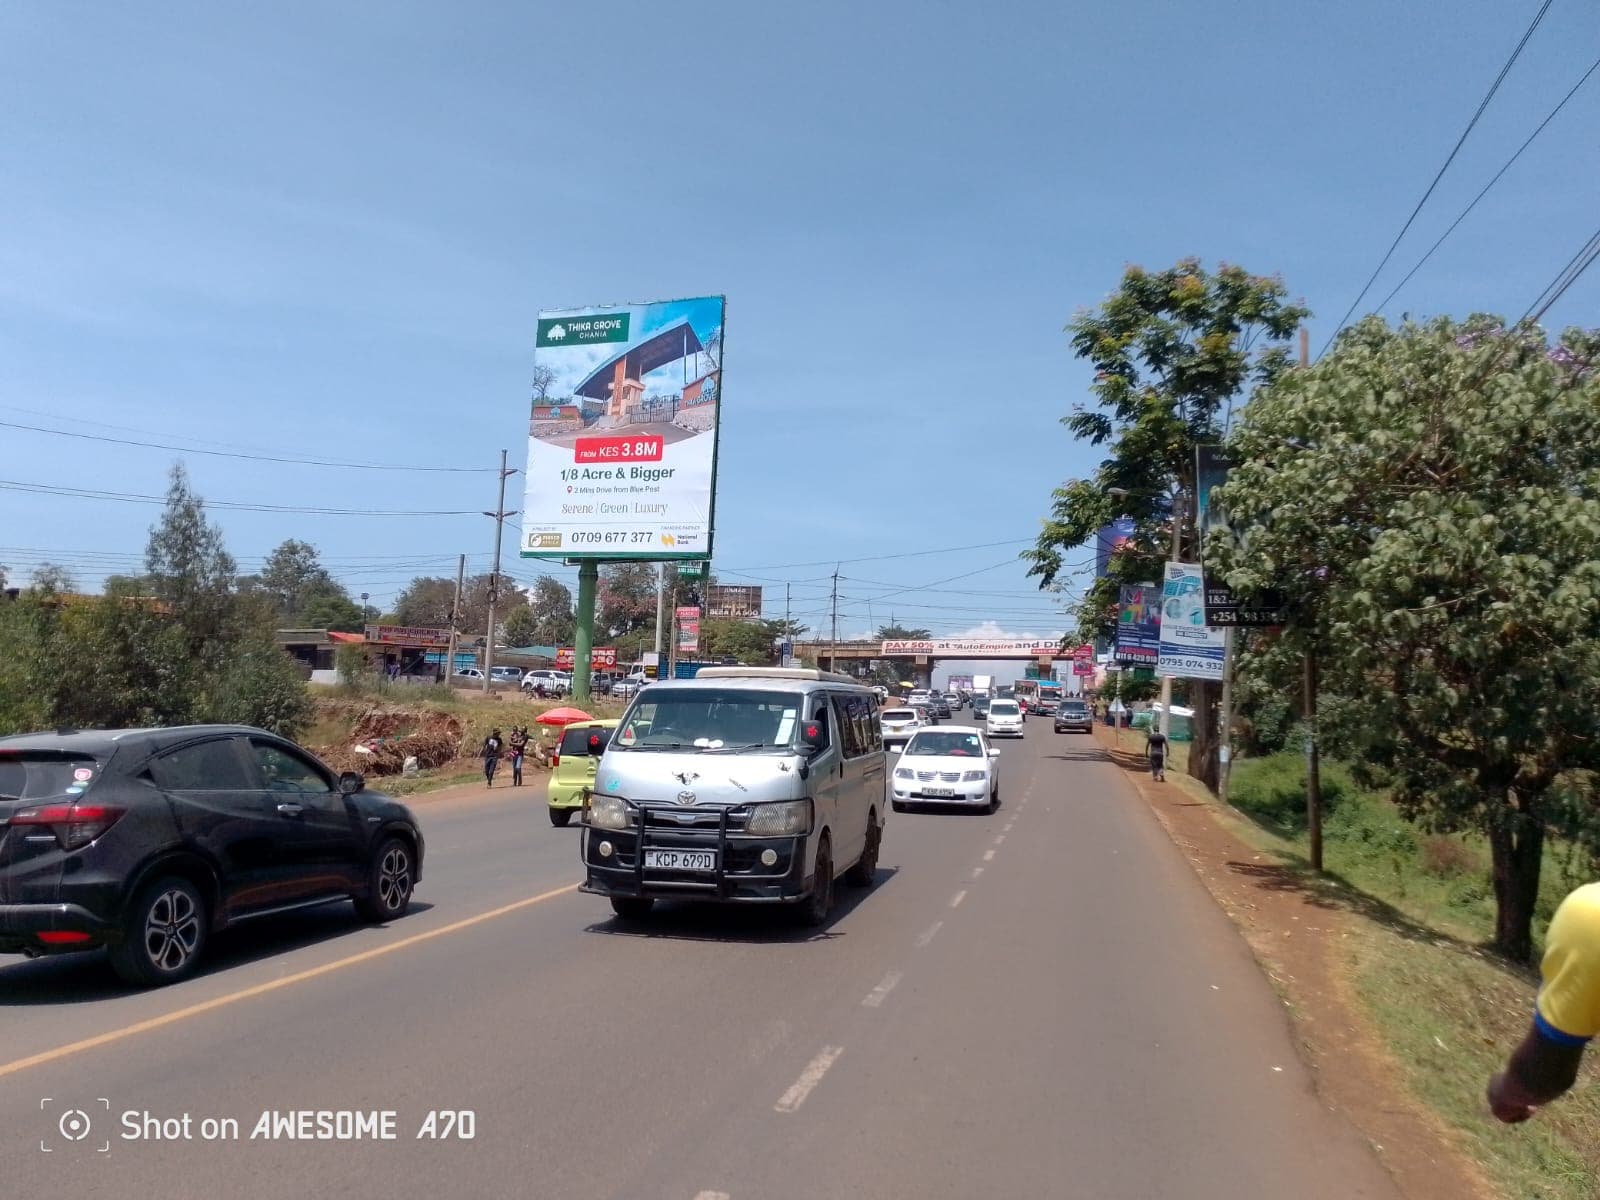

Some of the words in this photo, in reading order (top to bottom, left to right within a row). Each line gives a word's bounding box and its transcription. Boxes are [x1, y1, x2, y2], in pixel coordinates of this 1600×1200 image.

[568, 321, 591, 332] THIKA
[594, 319, 621, 330] GROVE
[579, 330, 607, 339] CHANIA
[599, 446, 619, 457] KES
[621, 441, 657, 457] 3.8M
[560, 468, 579, 482] 1/8
[581, 468, 612, 480] Acre
[615, 467, 626, 479] &
[630, 466, 675, 482] Bigger
[579, 486, 594, 494] Mins
[595, 486, 612, 494] Drive
[629, 485, 644, 493] Blue
[645, 485, 660, 493] Post
[561, 502, 594, 514] Serene
[600, 502, 628, 514] Green
[634, 502, 668, 516] Luxury
[571, 532, 602, 543] 0709
[605, 532, 630, 543] 677
[631, 531, 653, 543] 377
[1208, 595, 1227, 604] 1&2
[1211, 611, 1237, 622] +254
[1014, 641, 1040, 649] and
[1160, 657, 1183, 667] 0795
[1186, 659, 1204, 668] 074
[1206, 661, 1223, 671] 932
[655, 853, 678, 867] KCP
[682, 854, 711, 868] 679D
